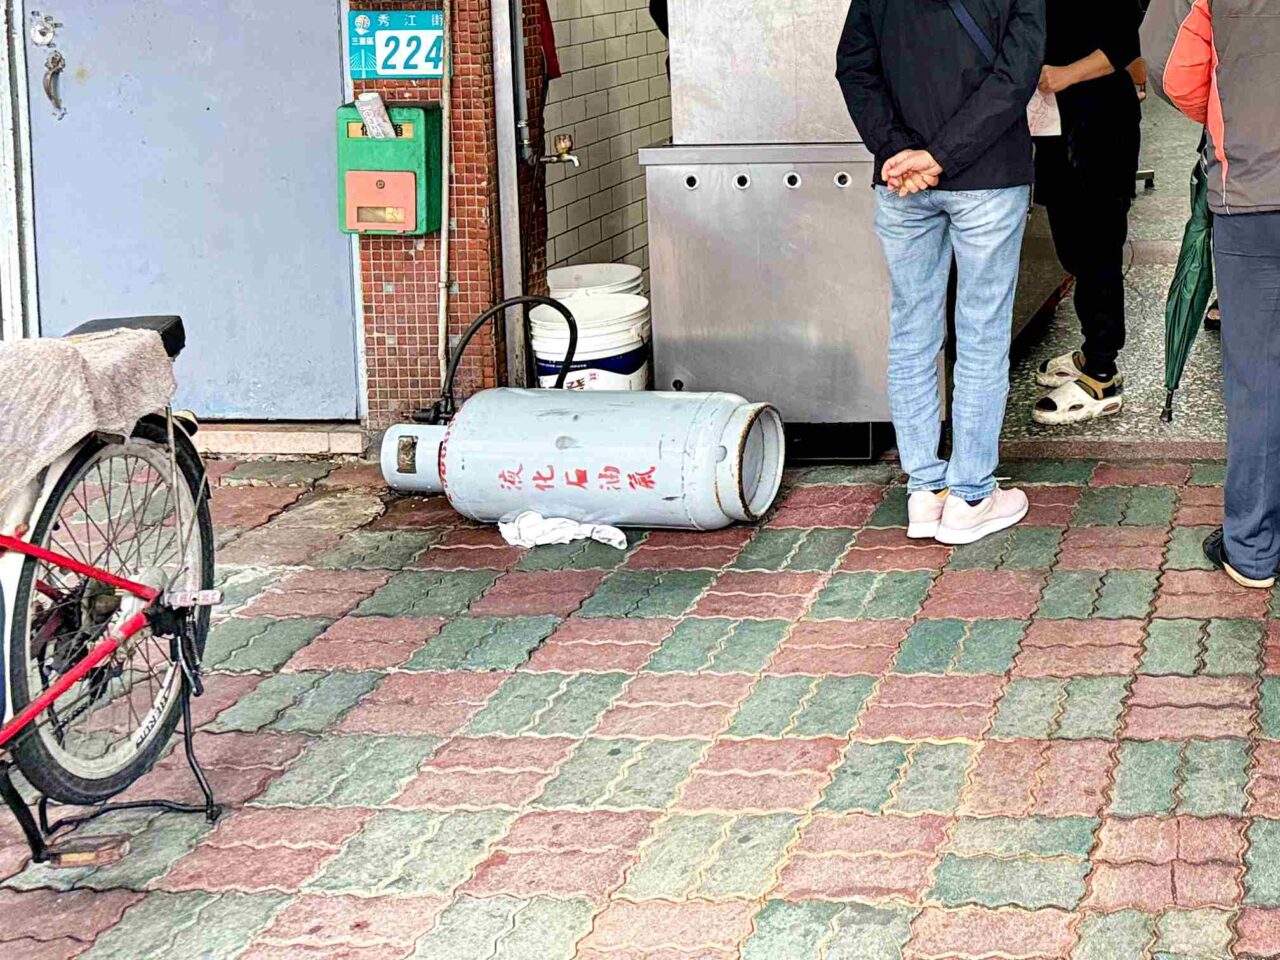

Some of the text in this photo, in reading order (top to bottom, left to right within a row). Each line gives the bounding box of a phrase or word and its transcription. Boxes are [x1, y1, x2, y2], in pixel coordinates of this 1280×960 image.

[378, 13, 443, 27] 秀江街
[381, 35, 443, 70] 224
[498, 463, 656, 492] 液化石油氣
